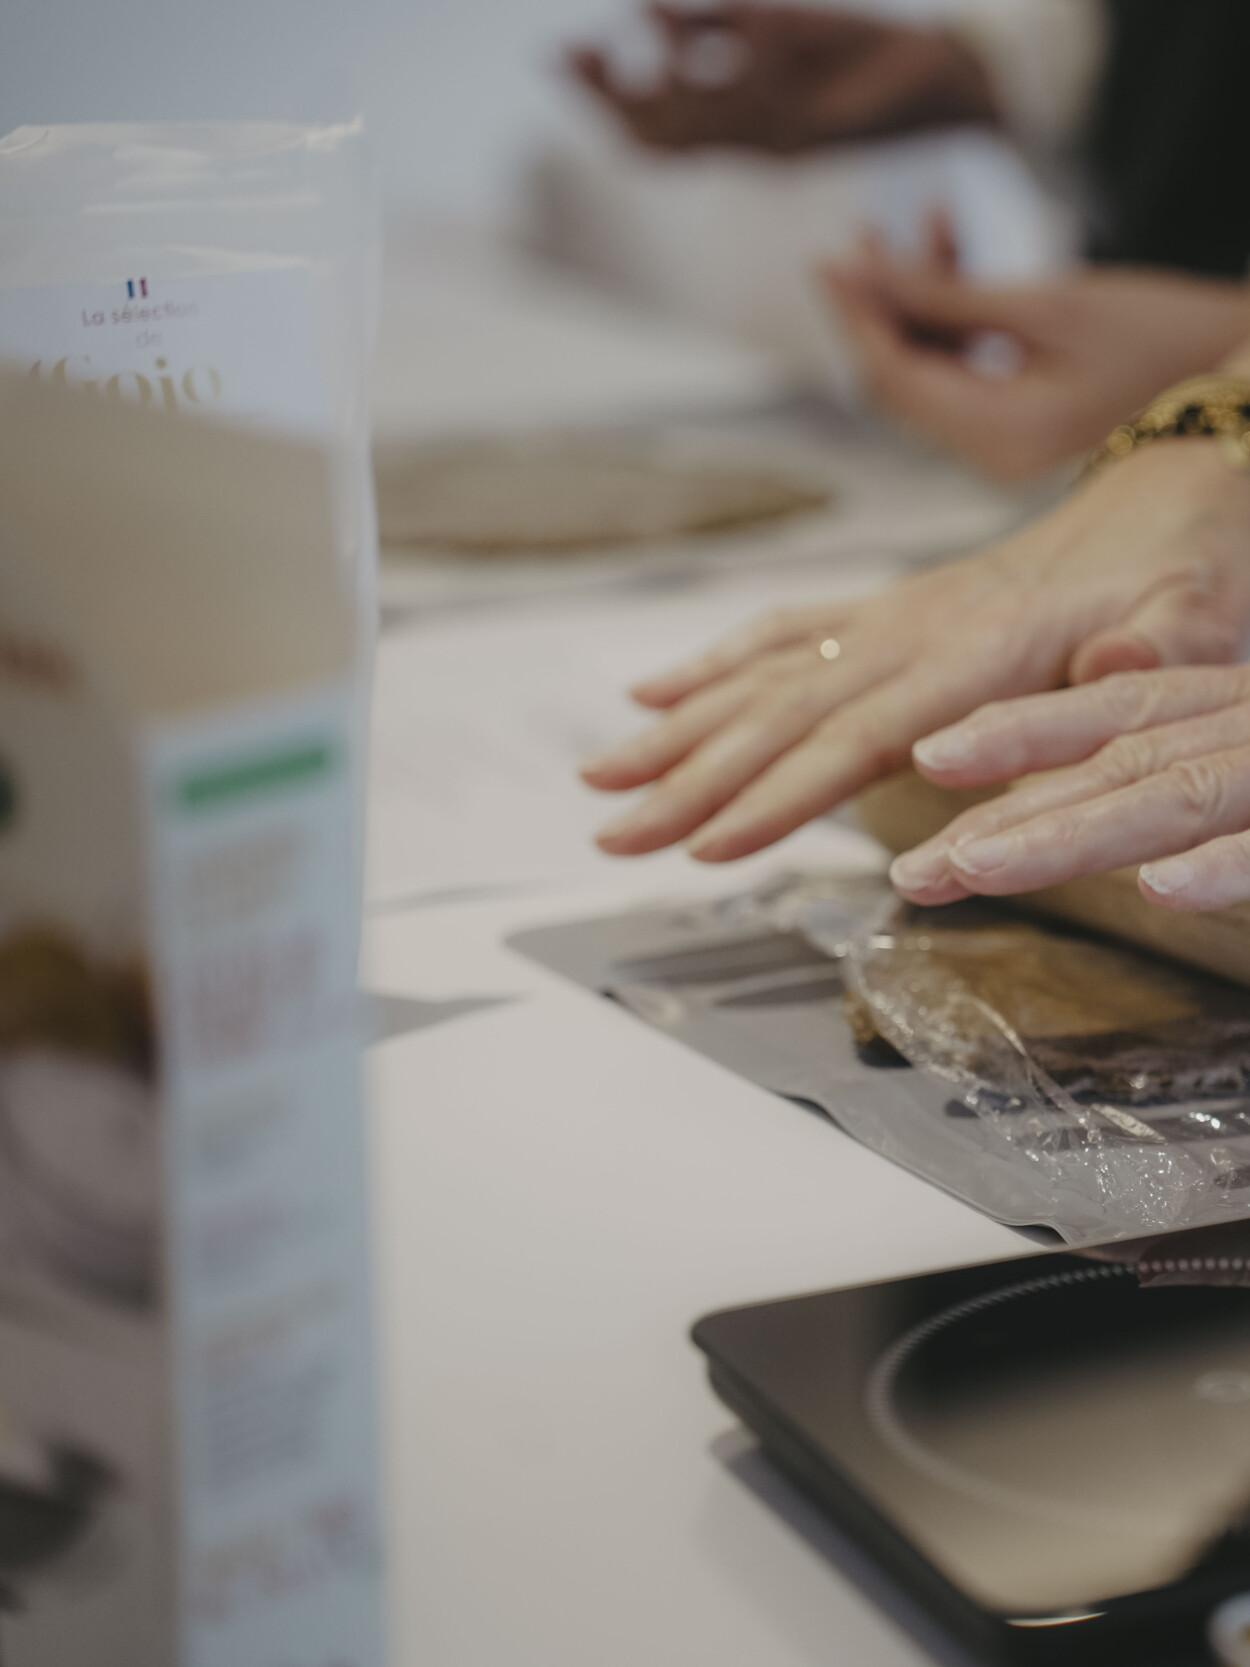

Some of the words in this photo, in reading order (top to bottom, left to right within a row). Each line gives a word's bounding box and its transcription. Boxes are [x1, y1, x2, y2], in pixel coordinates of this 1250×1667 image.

[81, 308, 104, 328] La
[111, 301, 199, 326] sélection
[135, 328, 164, 350] de
